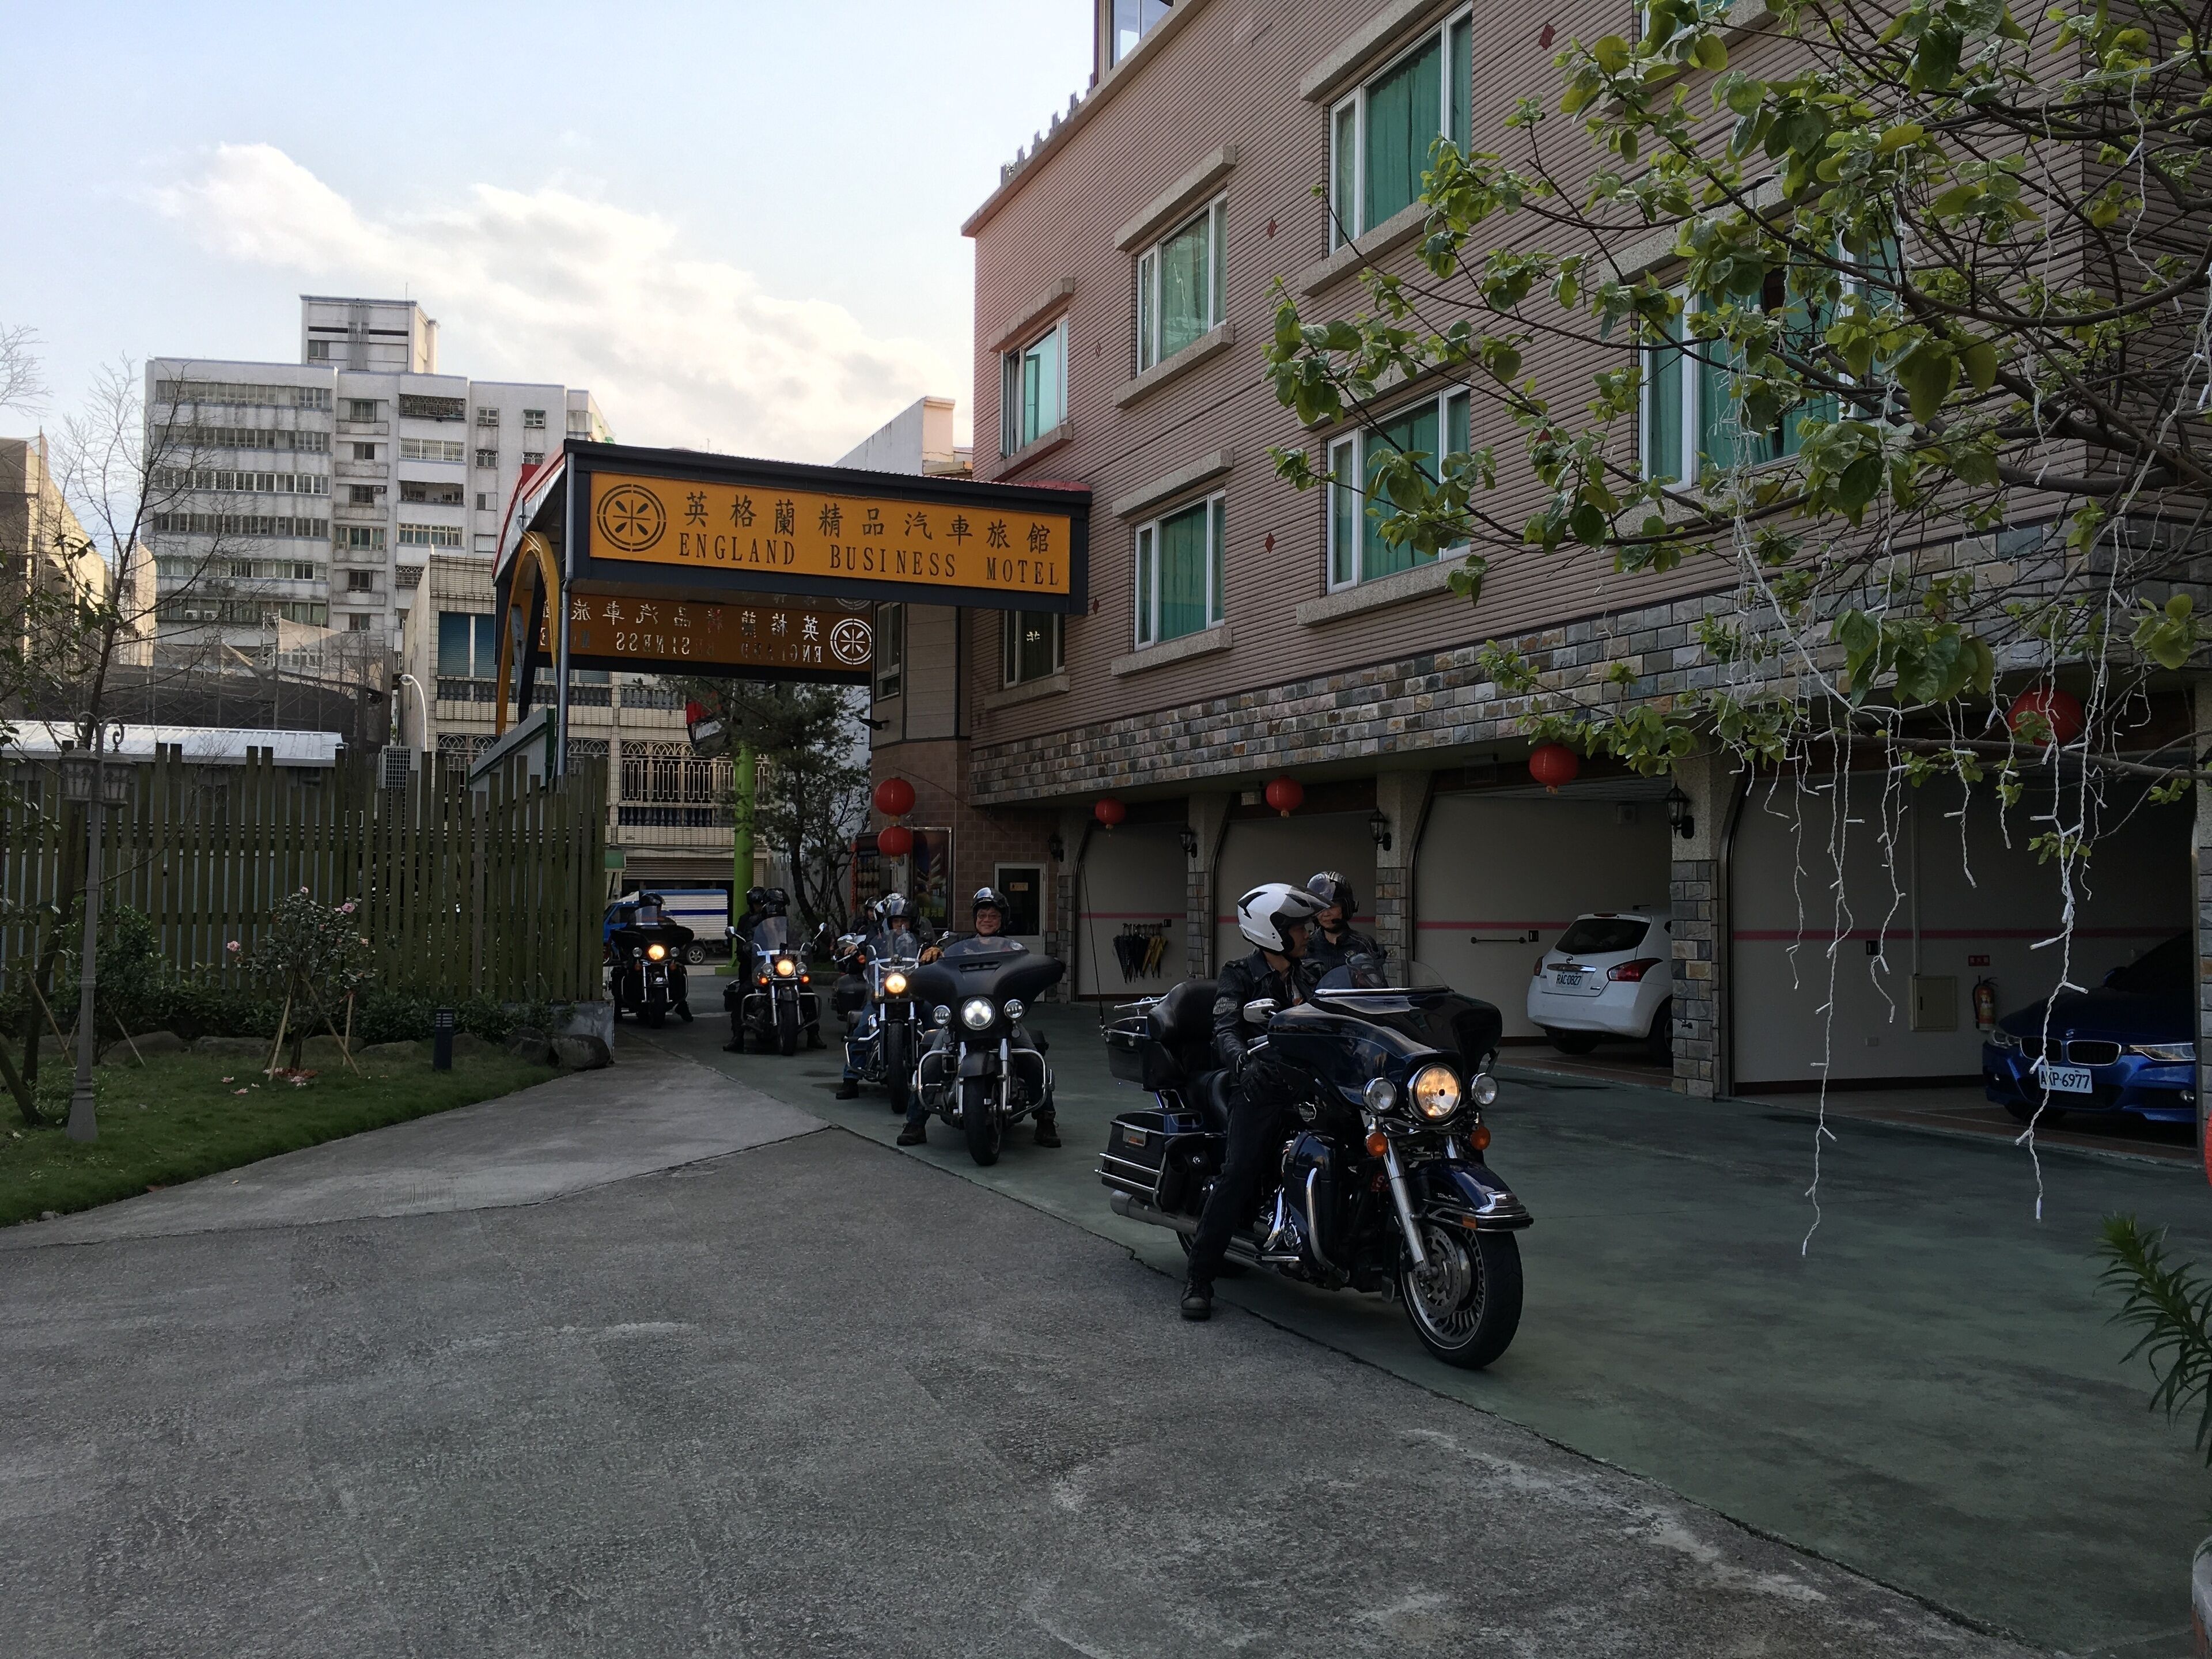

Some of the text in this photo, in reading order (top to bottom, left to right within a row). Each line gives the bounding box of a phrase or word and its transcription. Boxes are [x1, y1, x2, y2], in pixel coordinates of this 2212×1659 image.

[684, 491, 1051, 554] 英格蘭精品汽車旅館
[679, 532, 1059, 586] ENGLAND BUSINESS MOTEL
